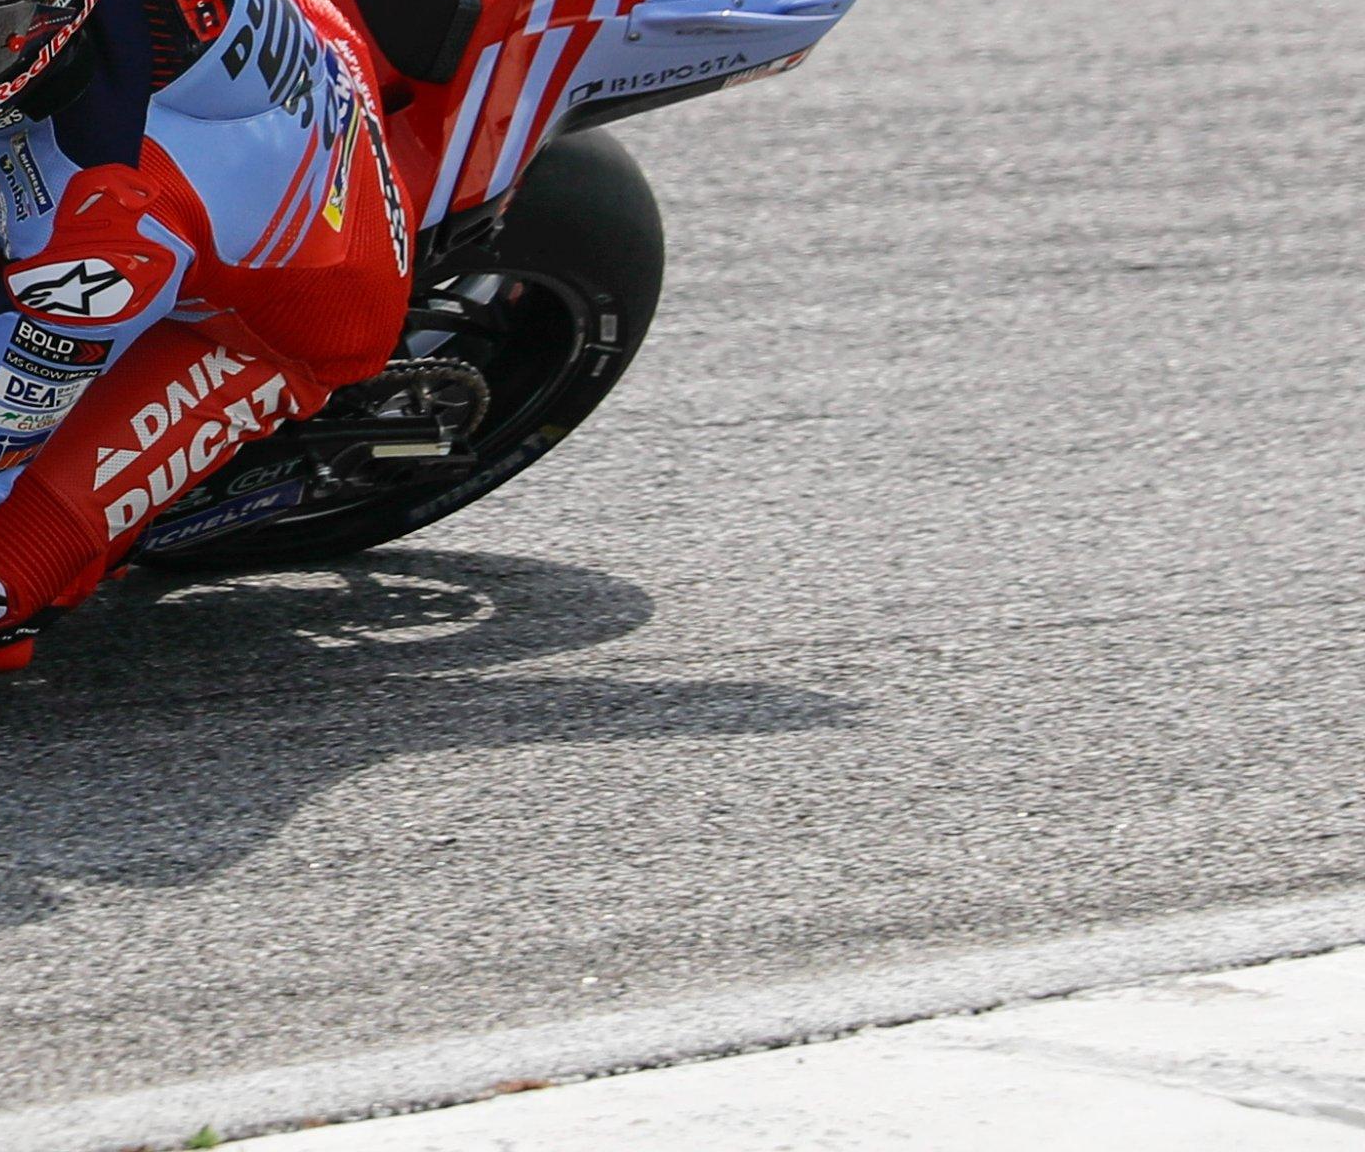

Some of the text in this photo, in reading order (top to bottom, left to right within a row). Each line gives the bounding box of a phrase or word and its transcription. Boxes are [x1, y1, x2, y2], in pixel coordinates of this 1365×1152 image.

[609, 51, 749, 93] RISPOSTA
[18, 152, 48, 206] MICHELIN
[18, 321, 75, 354] BOLD
[6, 351, 24, 368] MS
[25, 362, 63, 380] GLOW
